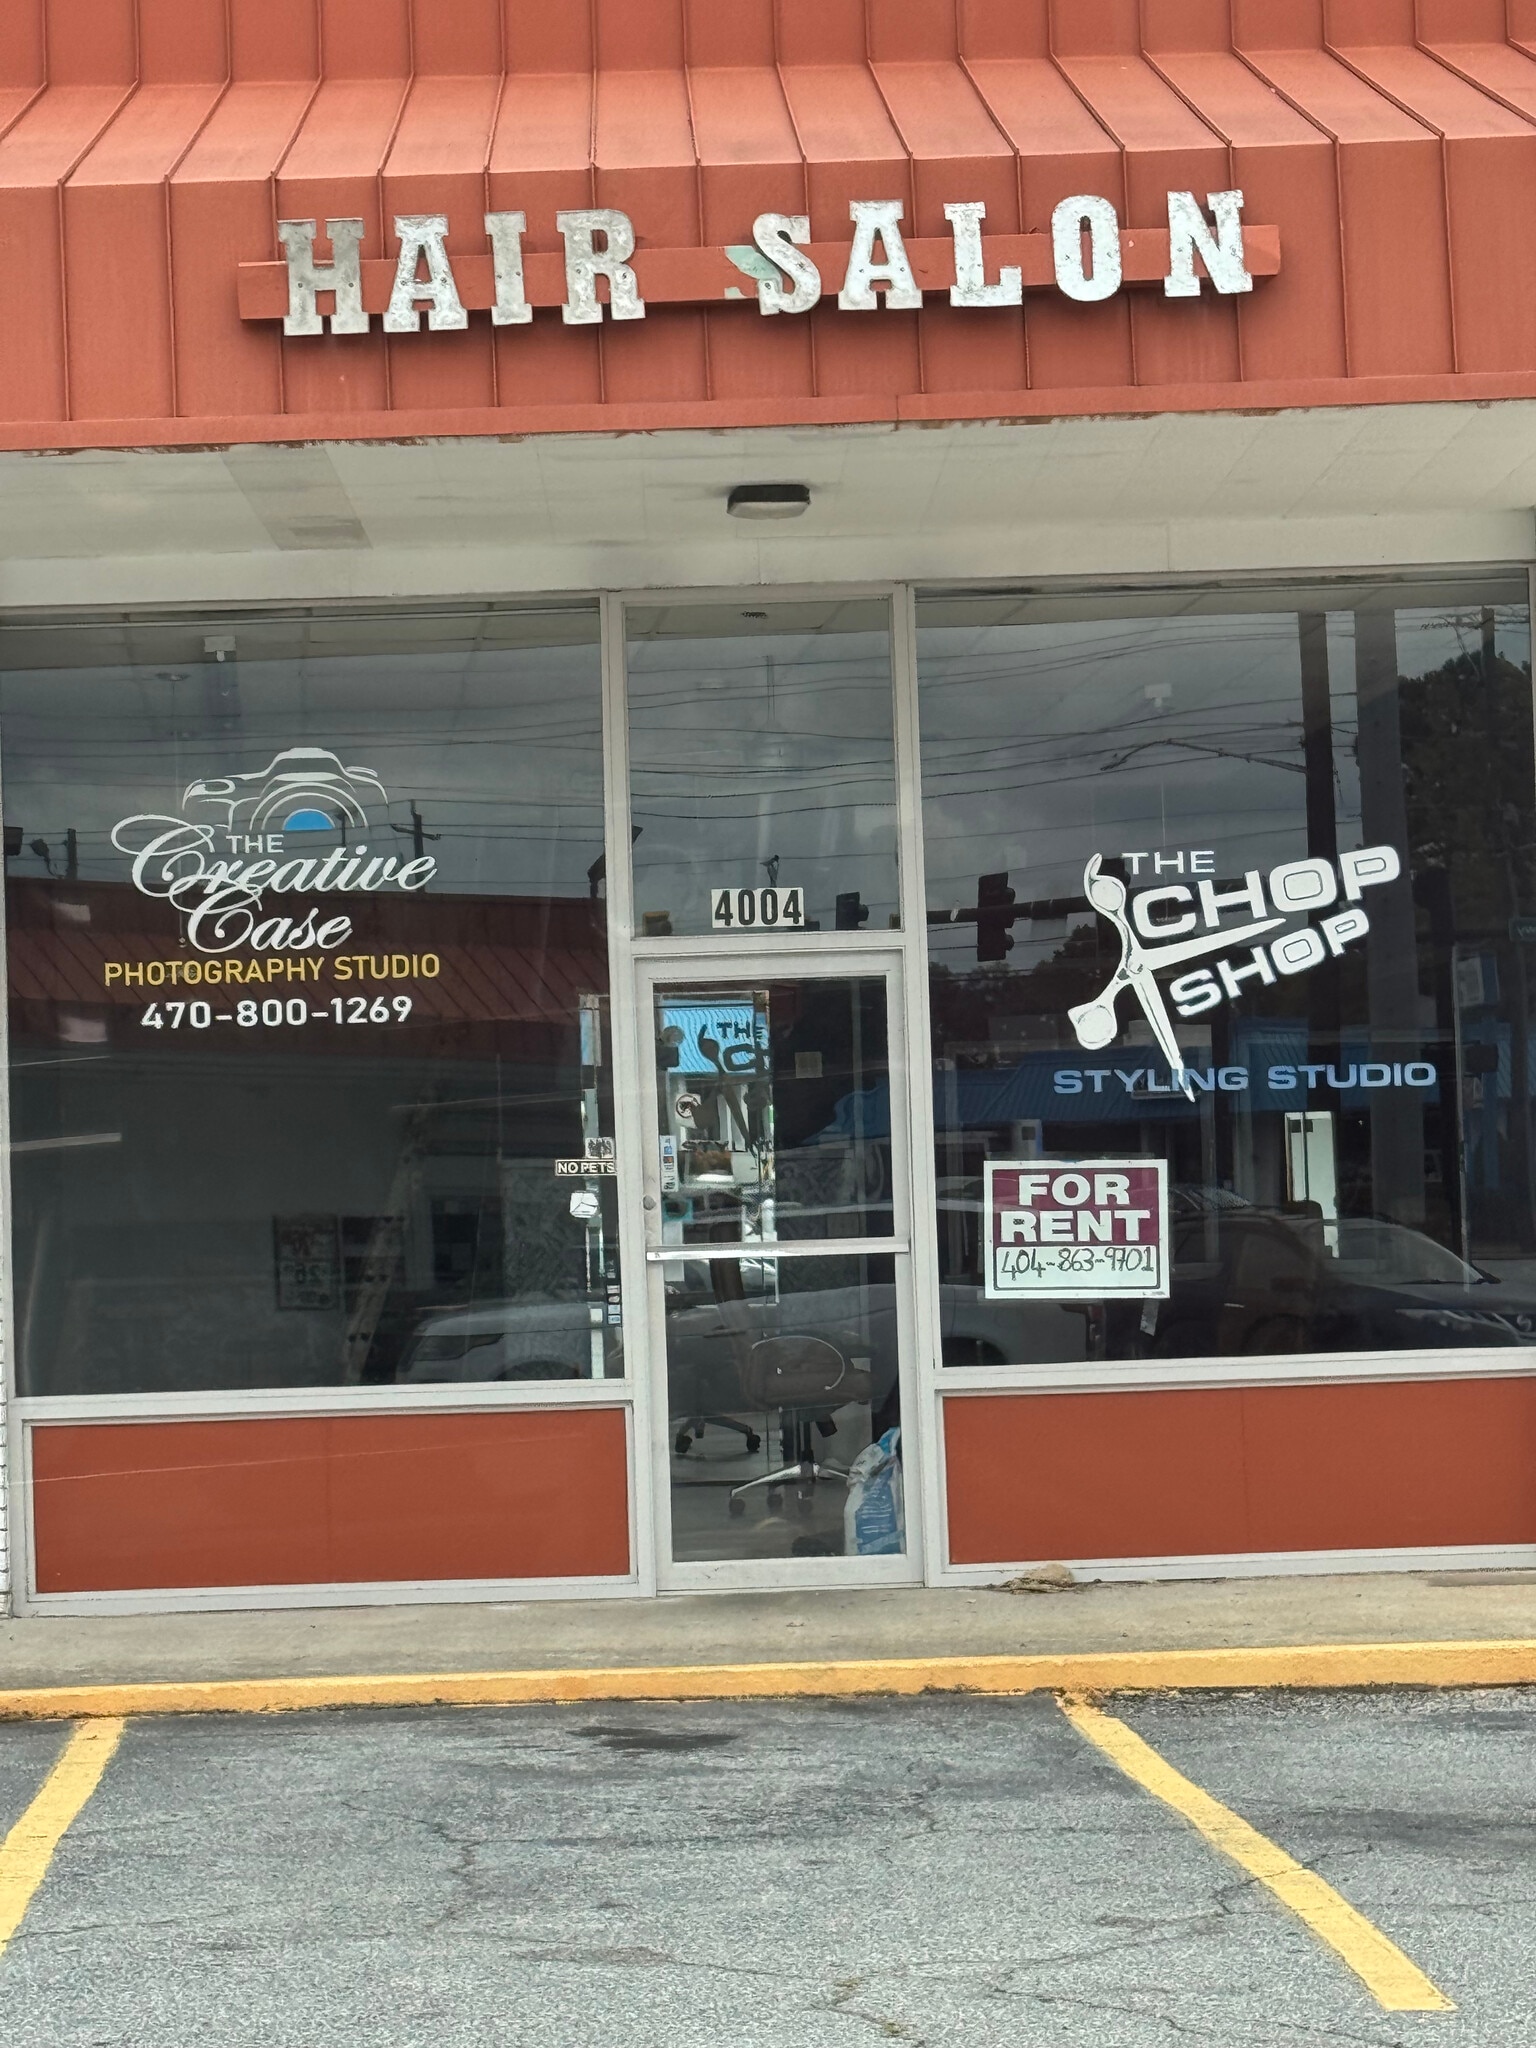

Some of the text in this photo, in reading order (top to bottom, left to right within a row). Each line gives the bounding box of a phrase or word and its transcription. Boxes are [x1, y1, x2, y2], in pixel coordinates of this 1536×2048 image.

[277, 188, 1254, 338] HAIR SALON
[110, 813, 438, 899] Creative
[225, 834, 285, 854] THE
[1121, 849, 1216, 875] THE
[714, 889, 802, 926] 4004
[1131, 845, 1401, 940] CHOP
[168, 873, 354, 954] Case
[103, 953, 441, 987] PHOTOGRAPHY STUDIO
[1168, 907, 1371, 1018] SHOP
[139, 995, 413, 1030] 470-800-1269
[1053, 1062, 1438, 1094] STYLING STUDIO
[557, 1161, 615, 1174] NO PETS
[1018, 1173, 1131, 1207] FOR
[1000, 1209, 1151, 1243] RENT
[1000, 1246, 1155, 1281] 404-863-9701
